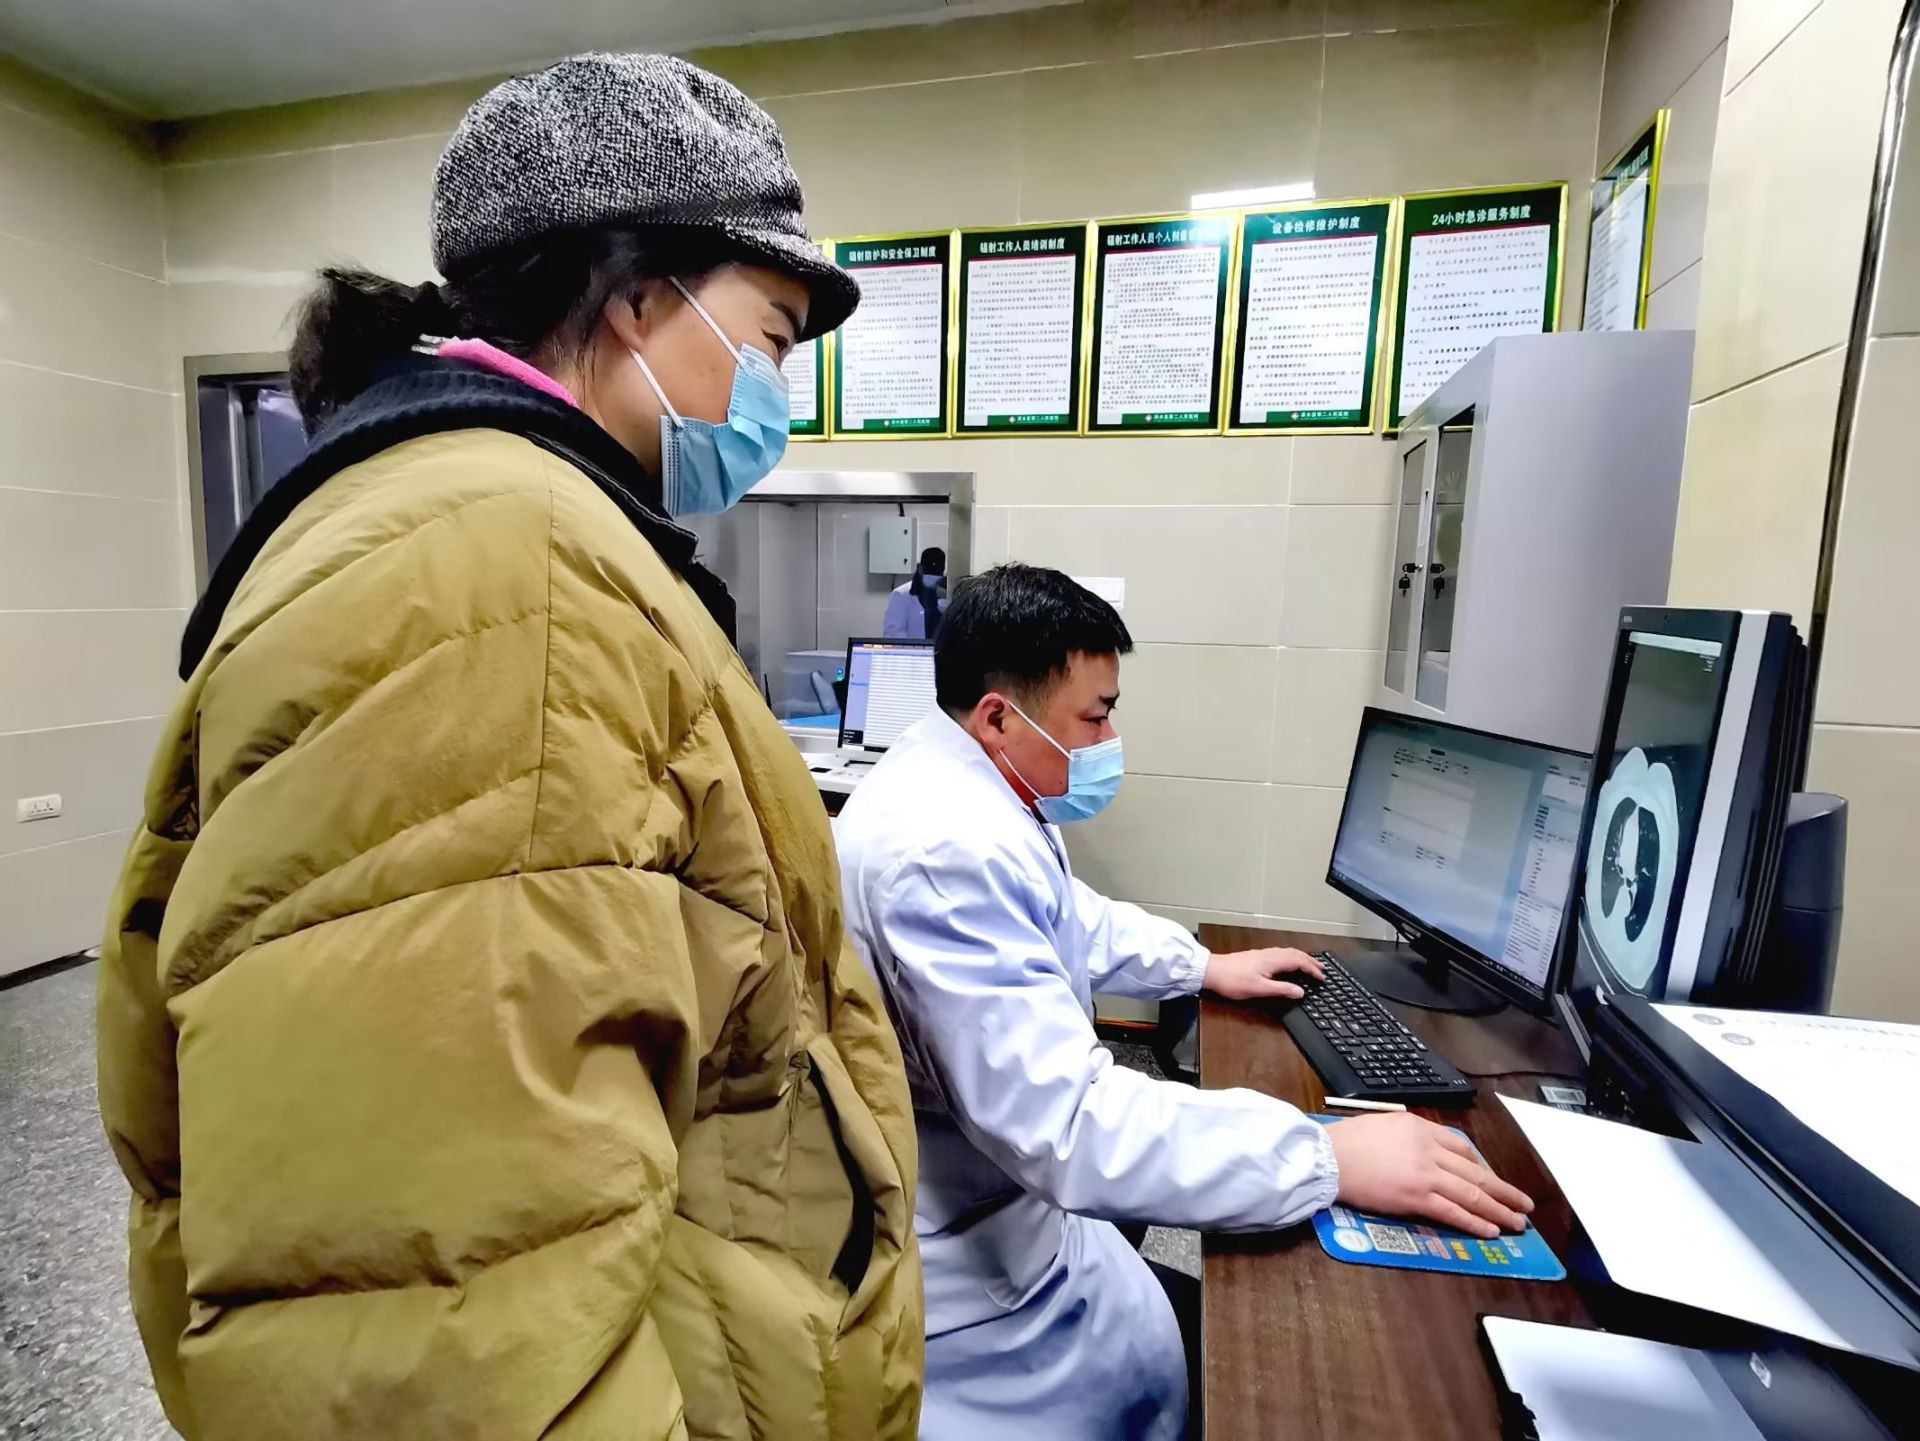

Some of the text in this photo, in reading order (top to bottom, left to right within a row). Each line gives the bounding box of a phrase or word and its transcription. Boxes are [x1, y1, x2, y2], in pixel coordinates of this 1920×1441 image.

[1431, 204, 1531, 226] 24小时急诊服务制度
[1272, 216, 1360, 235] 设备检修维护制度
[848, 245, 936, 262] 辐射防护和安全保卫制度
[980, 237, 1066, 254] 辐射工作人员培训制度
